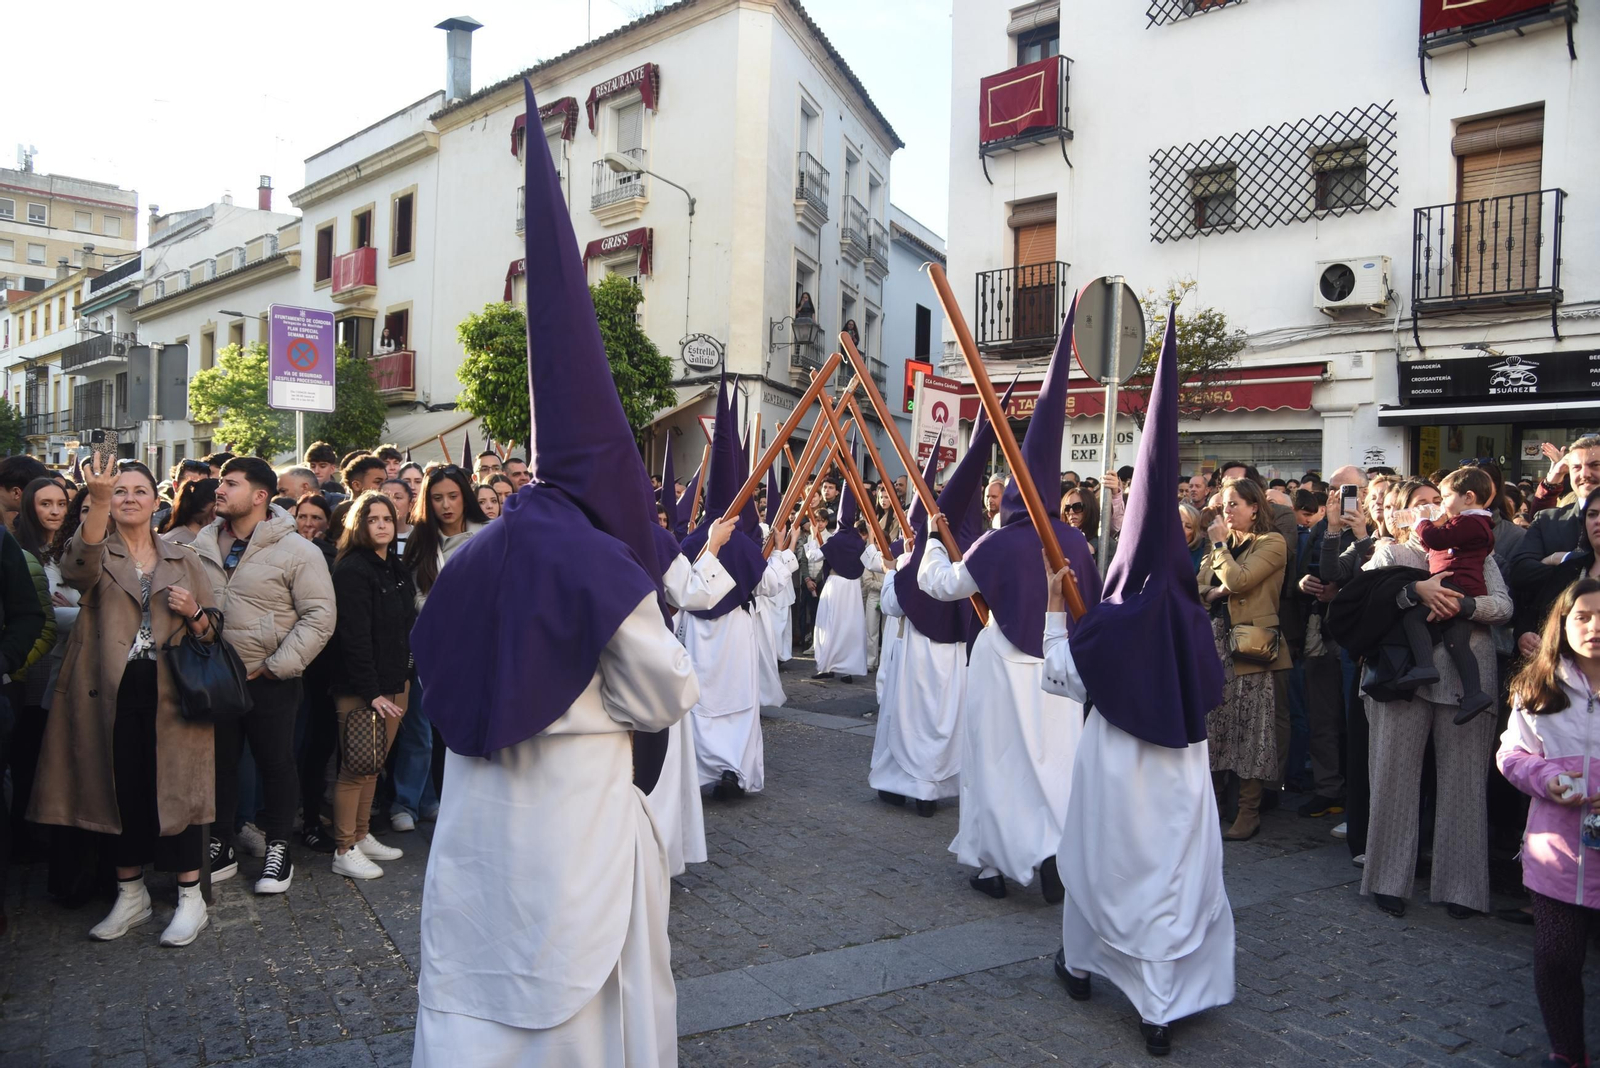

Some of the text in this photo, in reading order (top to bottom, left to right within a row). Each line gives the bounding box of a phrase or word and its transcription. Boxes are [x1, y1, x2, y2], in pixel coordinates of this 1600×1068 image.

[595, 66, 645, 98] RESTAURANTE
[274, 314, 305, 323] AYUNTAMIENTO
[688, 345, 715, 356] Estrella
[689, 354, 714, 365] Galicia
[296, 377, 331, 385] PROCESIONALES
[1496, 386, 1529, 394] SUÁREZ
[1071, 432, 1134, 444] TABAOS
[1071, 449, 1097, 460] EXP
